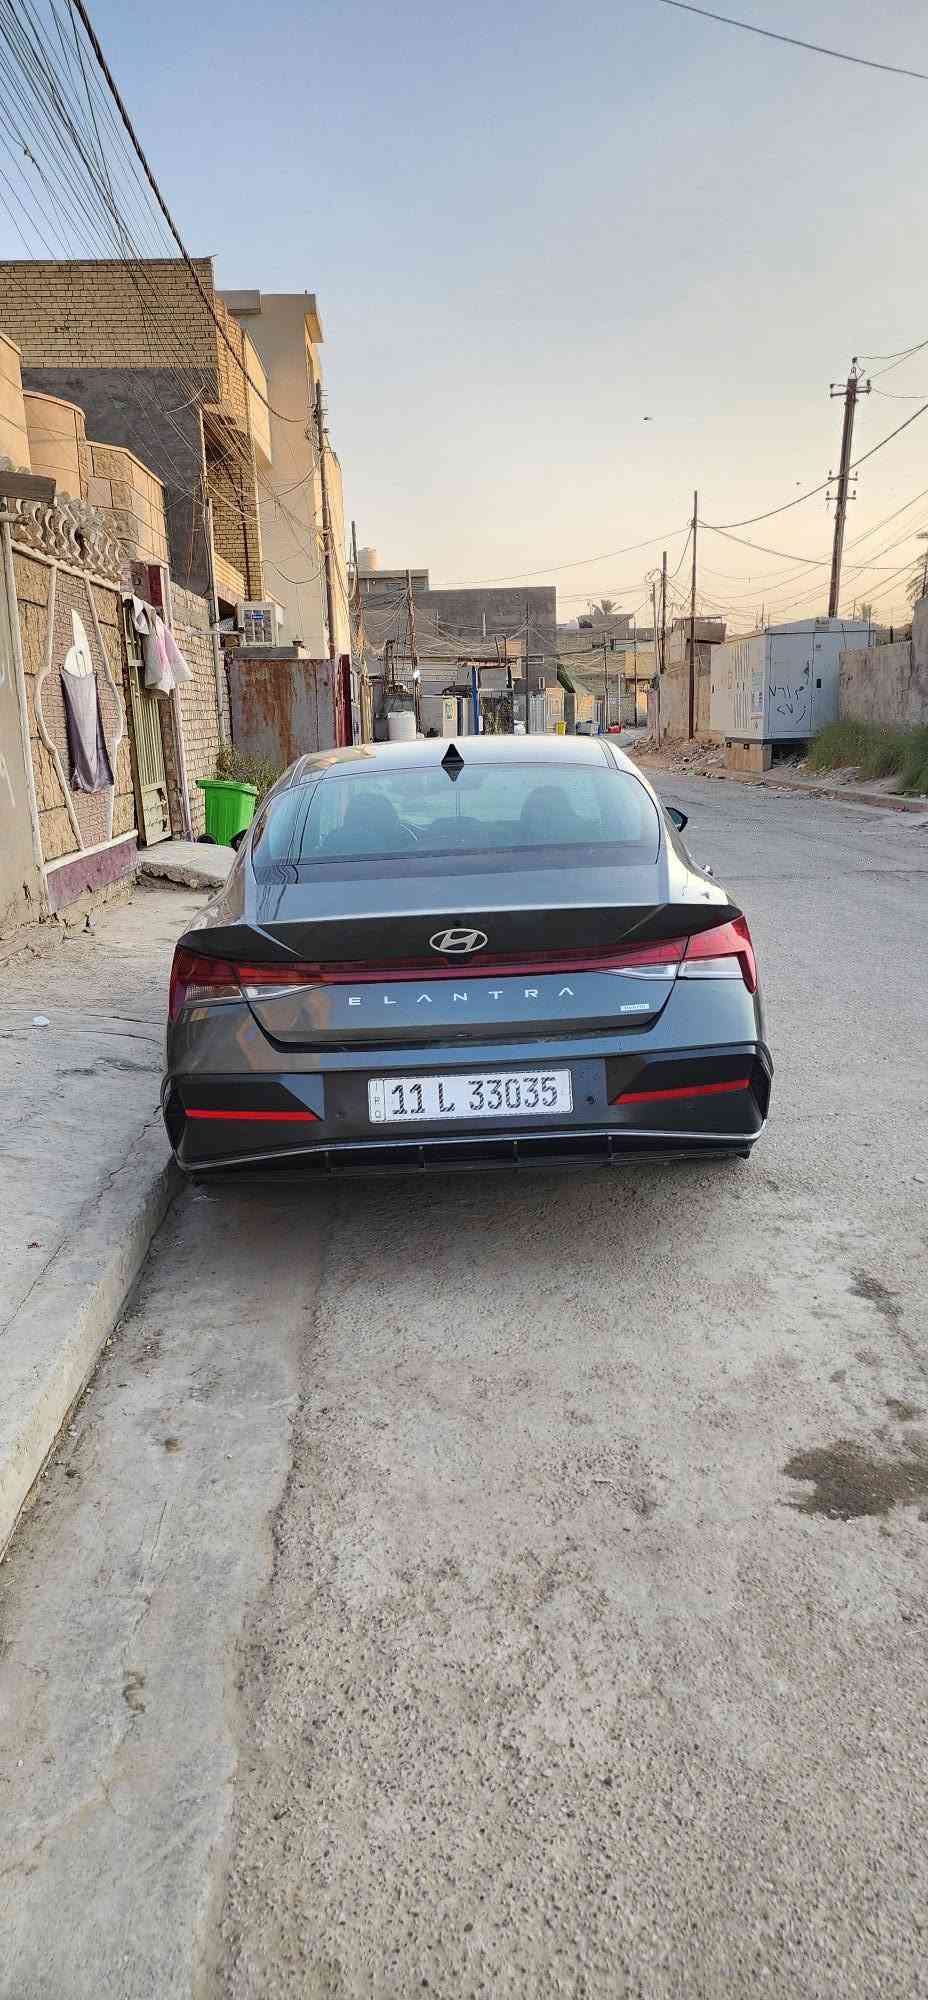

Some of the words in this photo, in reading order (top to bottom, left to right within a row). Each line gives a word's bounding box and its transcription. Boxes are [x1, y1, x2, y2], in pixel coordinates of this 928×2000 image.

[348, 986, 575, 1006] ELANTRA
[392, 1083, 425, 1115] 11
[438, 1082, 456, 1112] L
[467, 1076, 558, 1111] 33035
